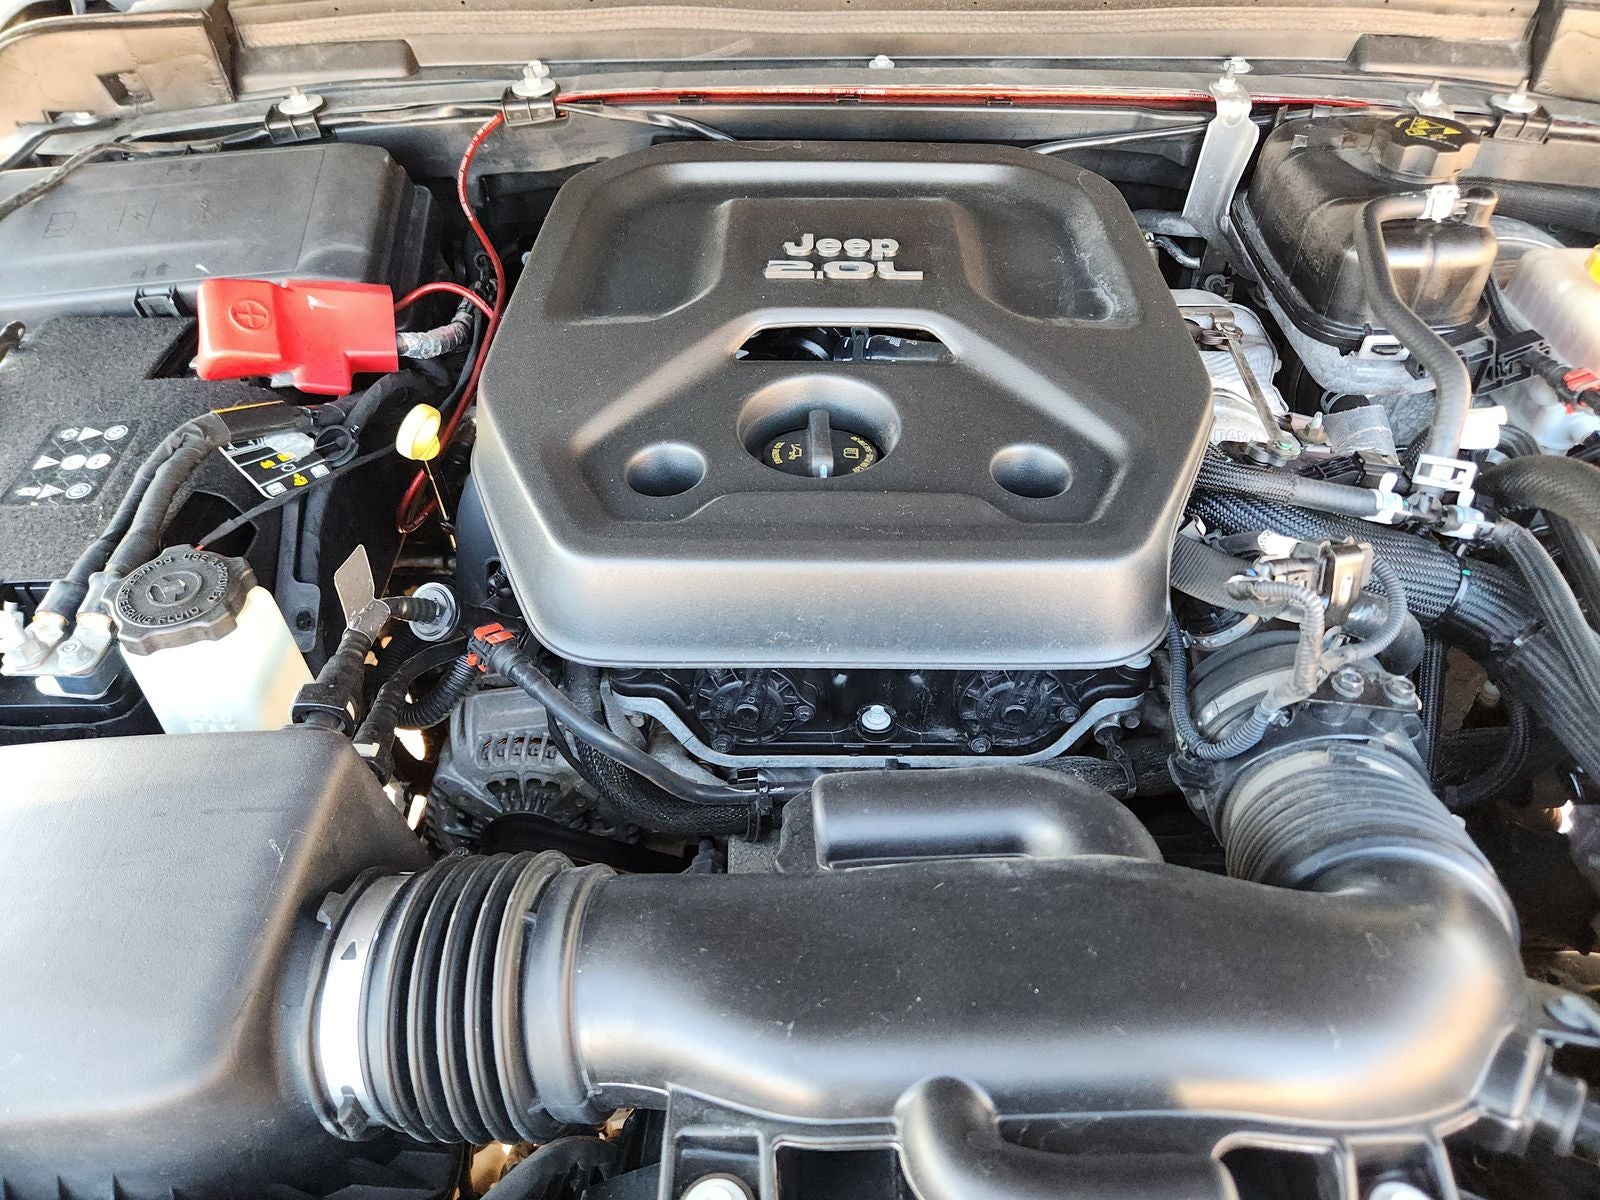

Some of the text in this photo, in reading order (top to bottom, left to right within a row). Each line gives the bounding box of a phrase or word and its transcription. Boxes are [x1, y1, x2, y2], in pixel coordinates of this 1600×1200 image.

[782, 233, 900, 261] Jeep
[764, 259, 924, 281] 2.0L
[130, 555, 176, 585] POWER
[157, 606, 201, 625] FLUID
[183, 551, 229, 603] USE APPROVED
